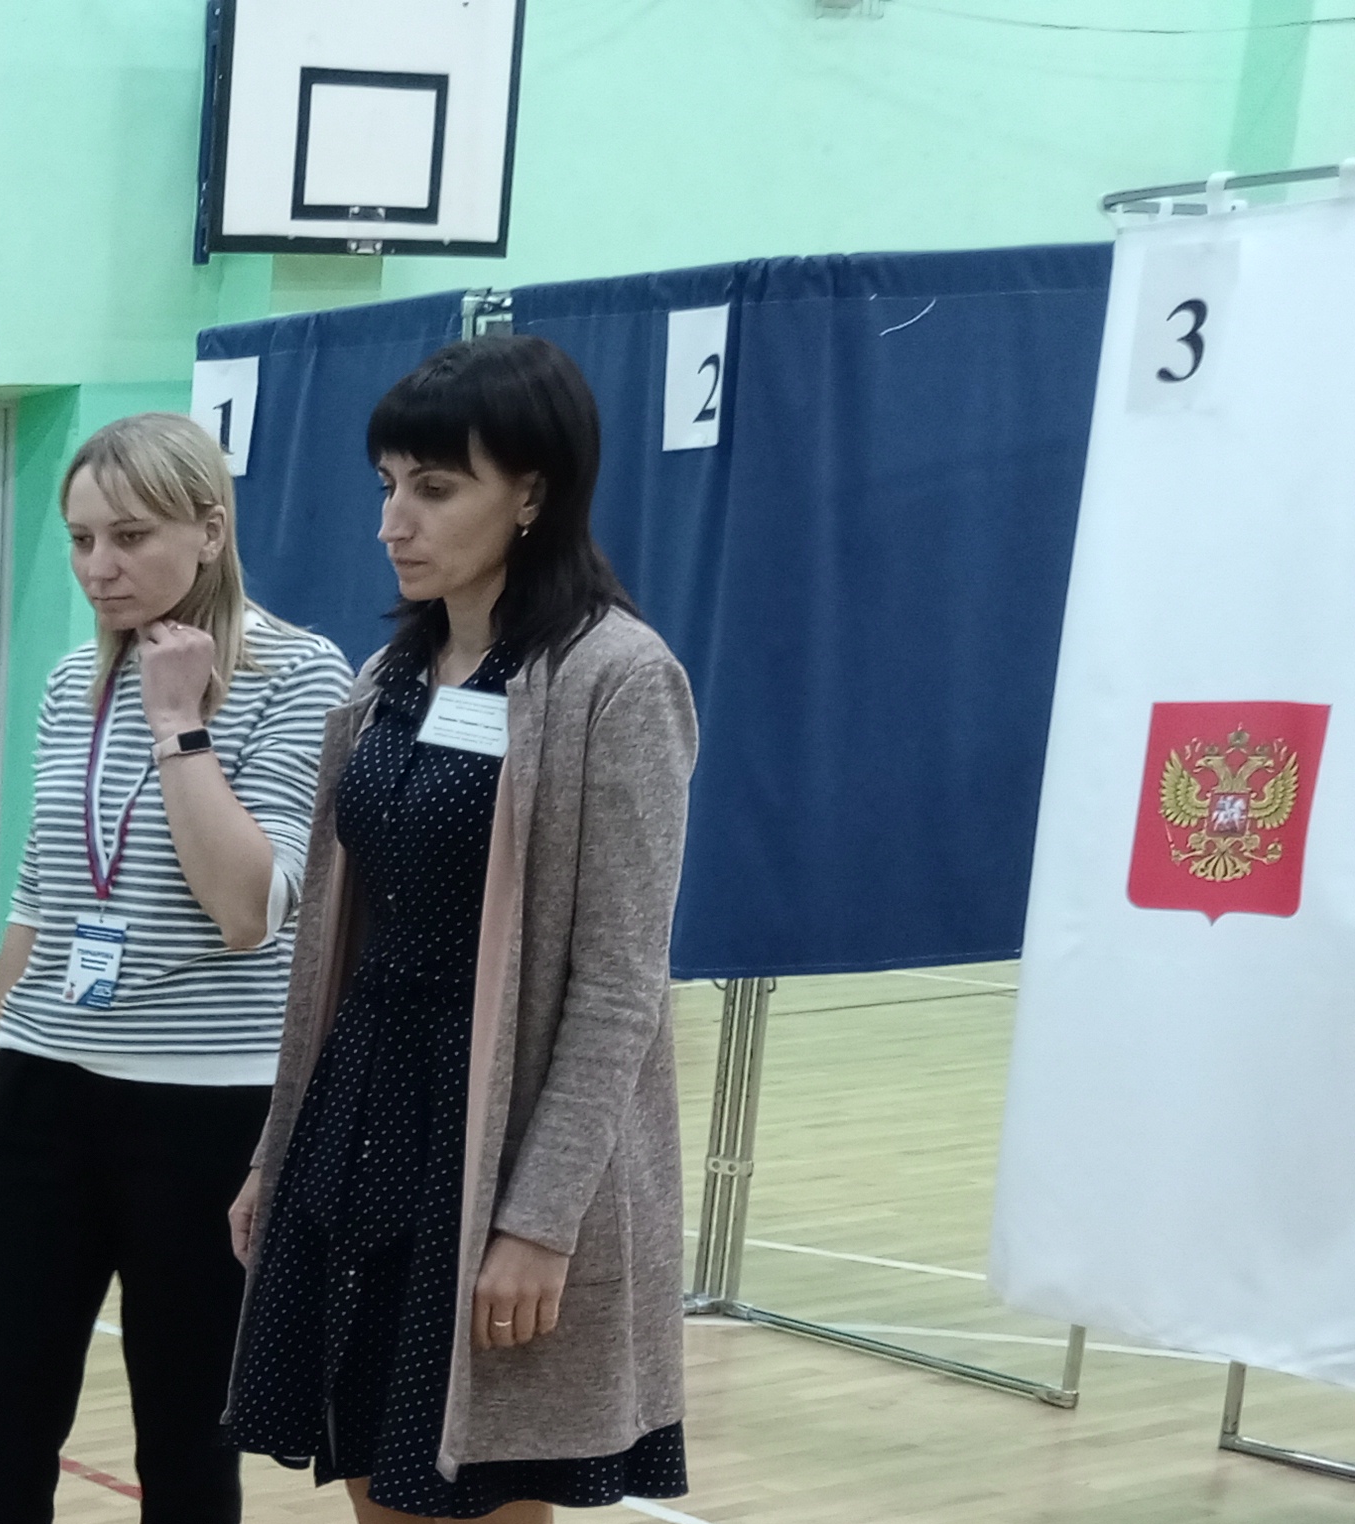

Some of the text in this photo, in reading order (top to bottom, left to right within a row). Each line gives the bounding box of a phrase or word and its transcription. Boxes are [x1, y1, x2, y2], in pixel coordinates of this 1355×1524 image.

[1156, 297, 1209, 383] 3
[692, 352, 721, 424] 2
[212, 397, 236, 455] 1
